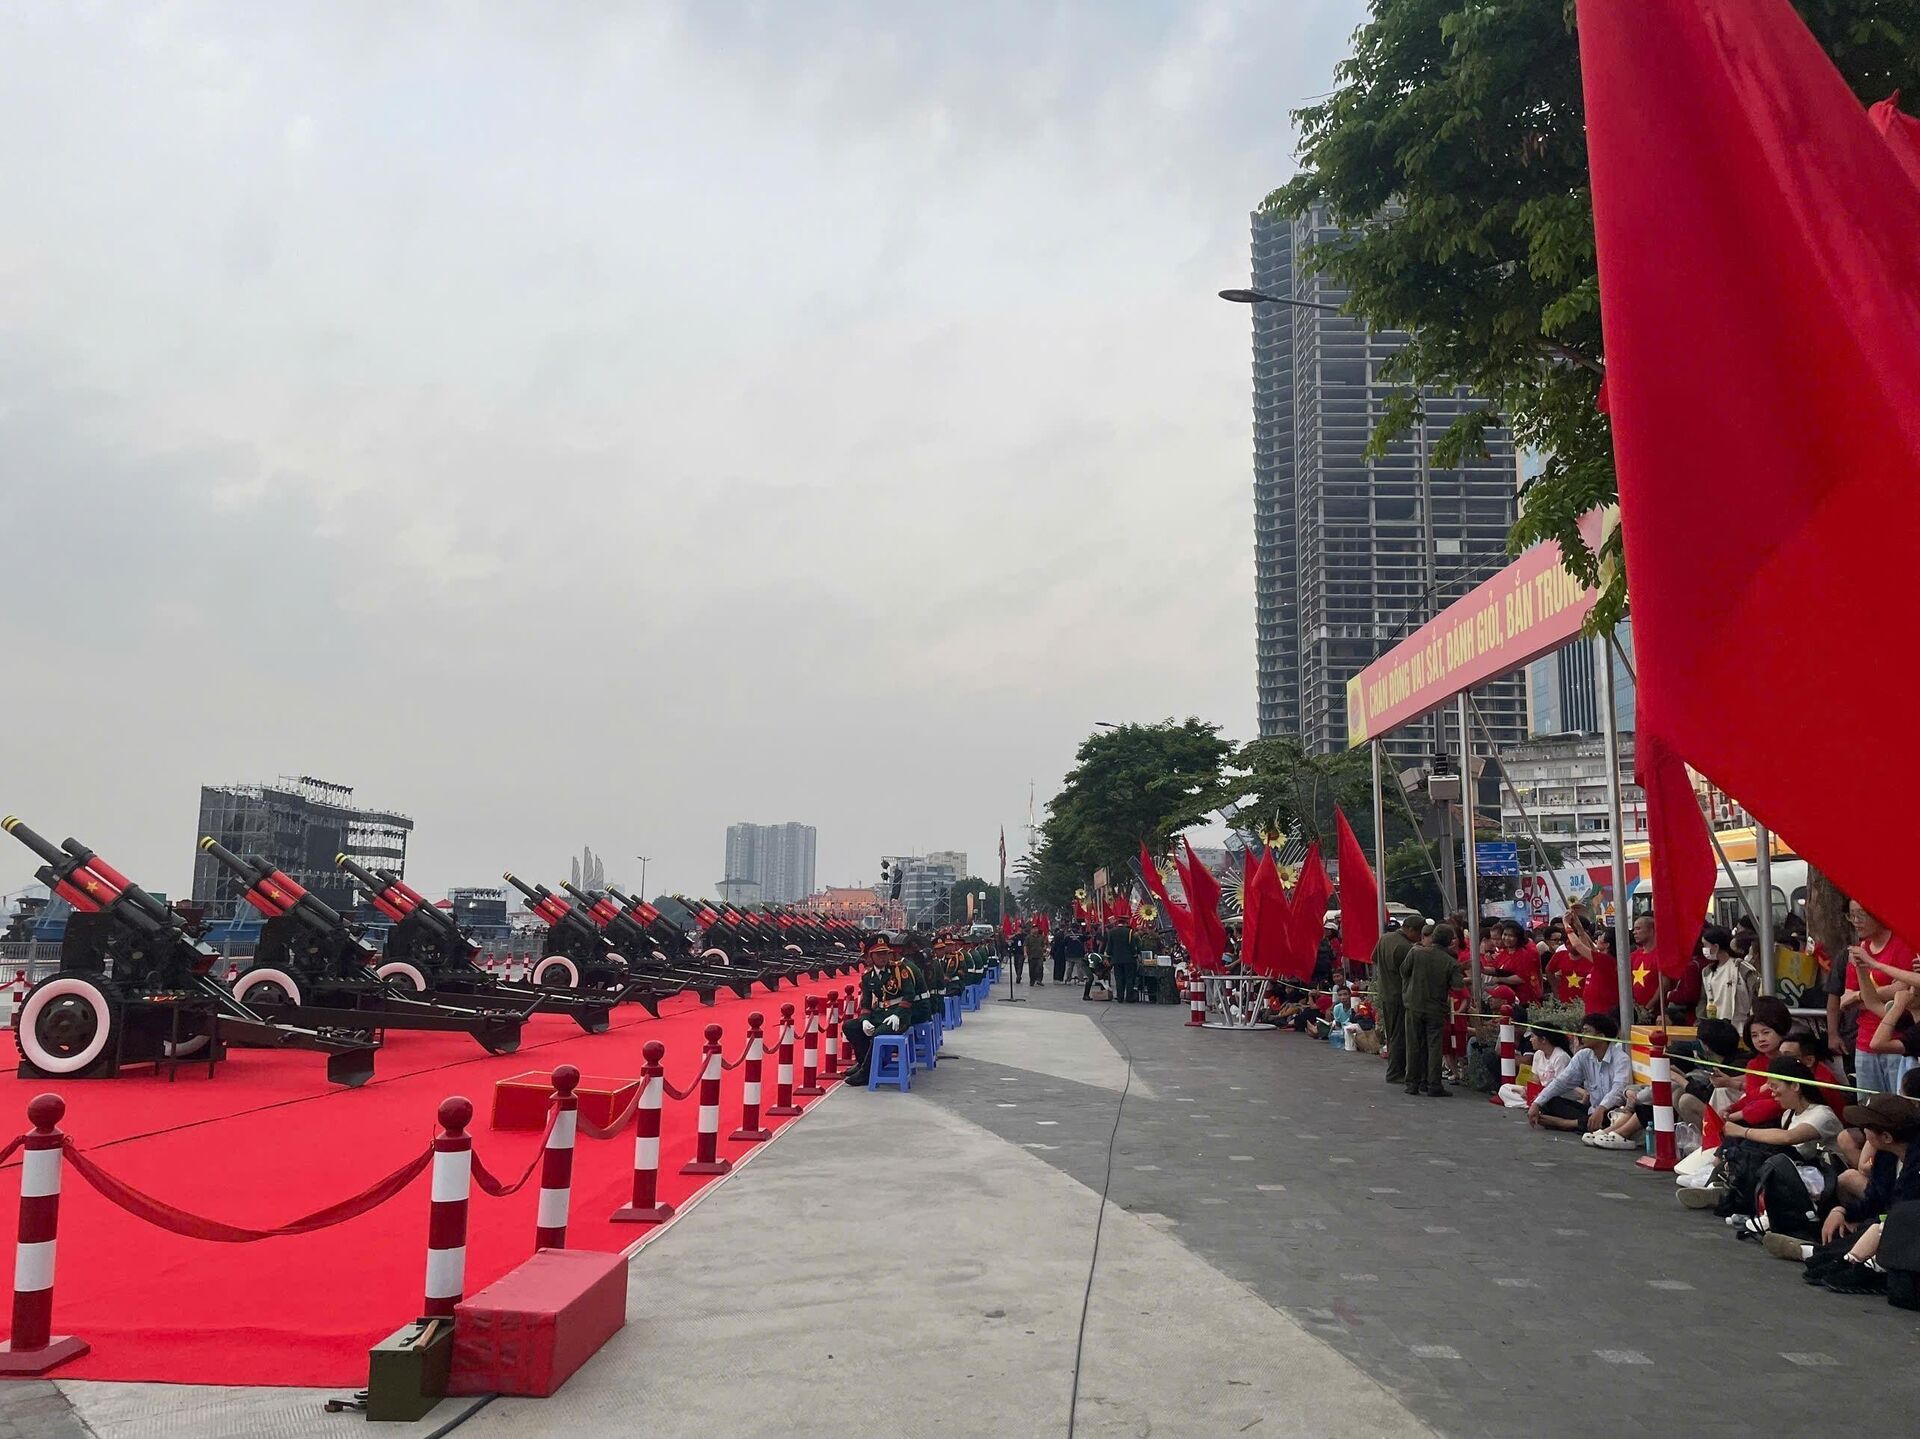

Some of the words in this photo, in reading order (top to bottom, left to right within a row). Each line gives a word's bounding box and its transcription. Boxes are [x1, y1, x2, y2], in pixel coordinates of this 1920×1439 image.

[1411, 650, 1425, 693] VAI
[1477, 590, 1504, 656] GIỎI,
[1506, 569, 1533, 640] BẮN
